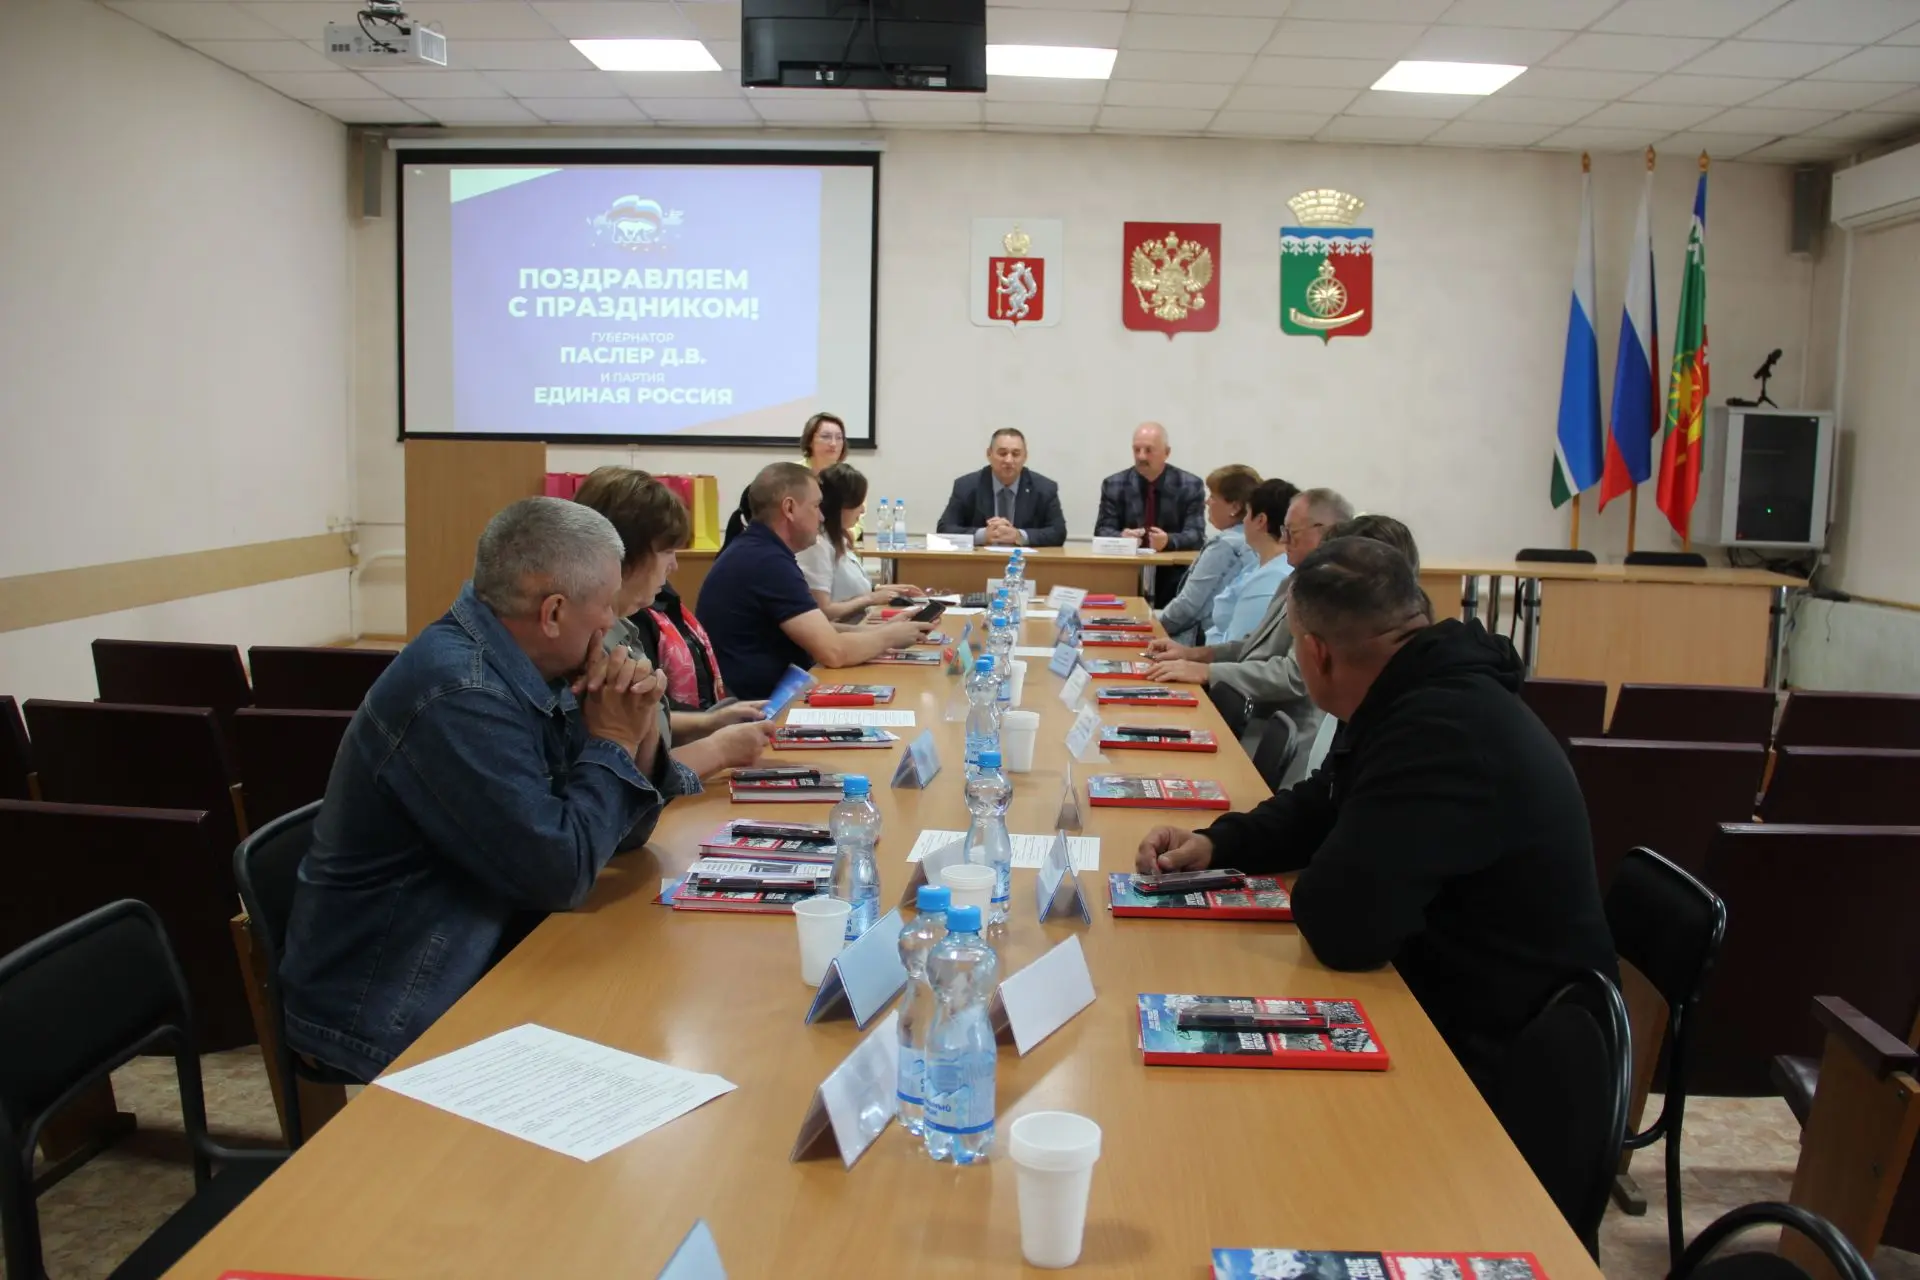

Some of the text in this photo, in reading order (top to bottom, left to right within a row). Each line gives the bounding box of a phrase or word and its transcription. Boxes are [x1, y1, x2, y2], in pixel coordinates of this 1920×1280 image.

[519, 268, 748, 292] ПОЗДРАВЛЯЕМ
[508, 296, 759, 321] С ПРАЗДНИКОМ!
[591, 332, 675, 344] ГУБЕРНАТОР
[560, 346, 707, 366] ПАСЛЕР Д.В.
[600, 372, 665, 383] И ПАРТИЯ
[534, 386, 733, 406] ЕДИНАЯ РОССИЯ
